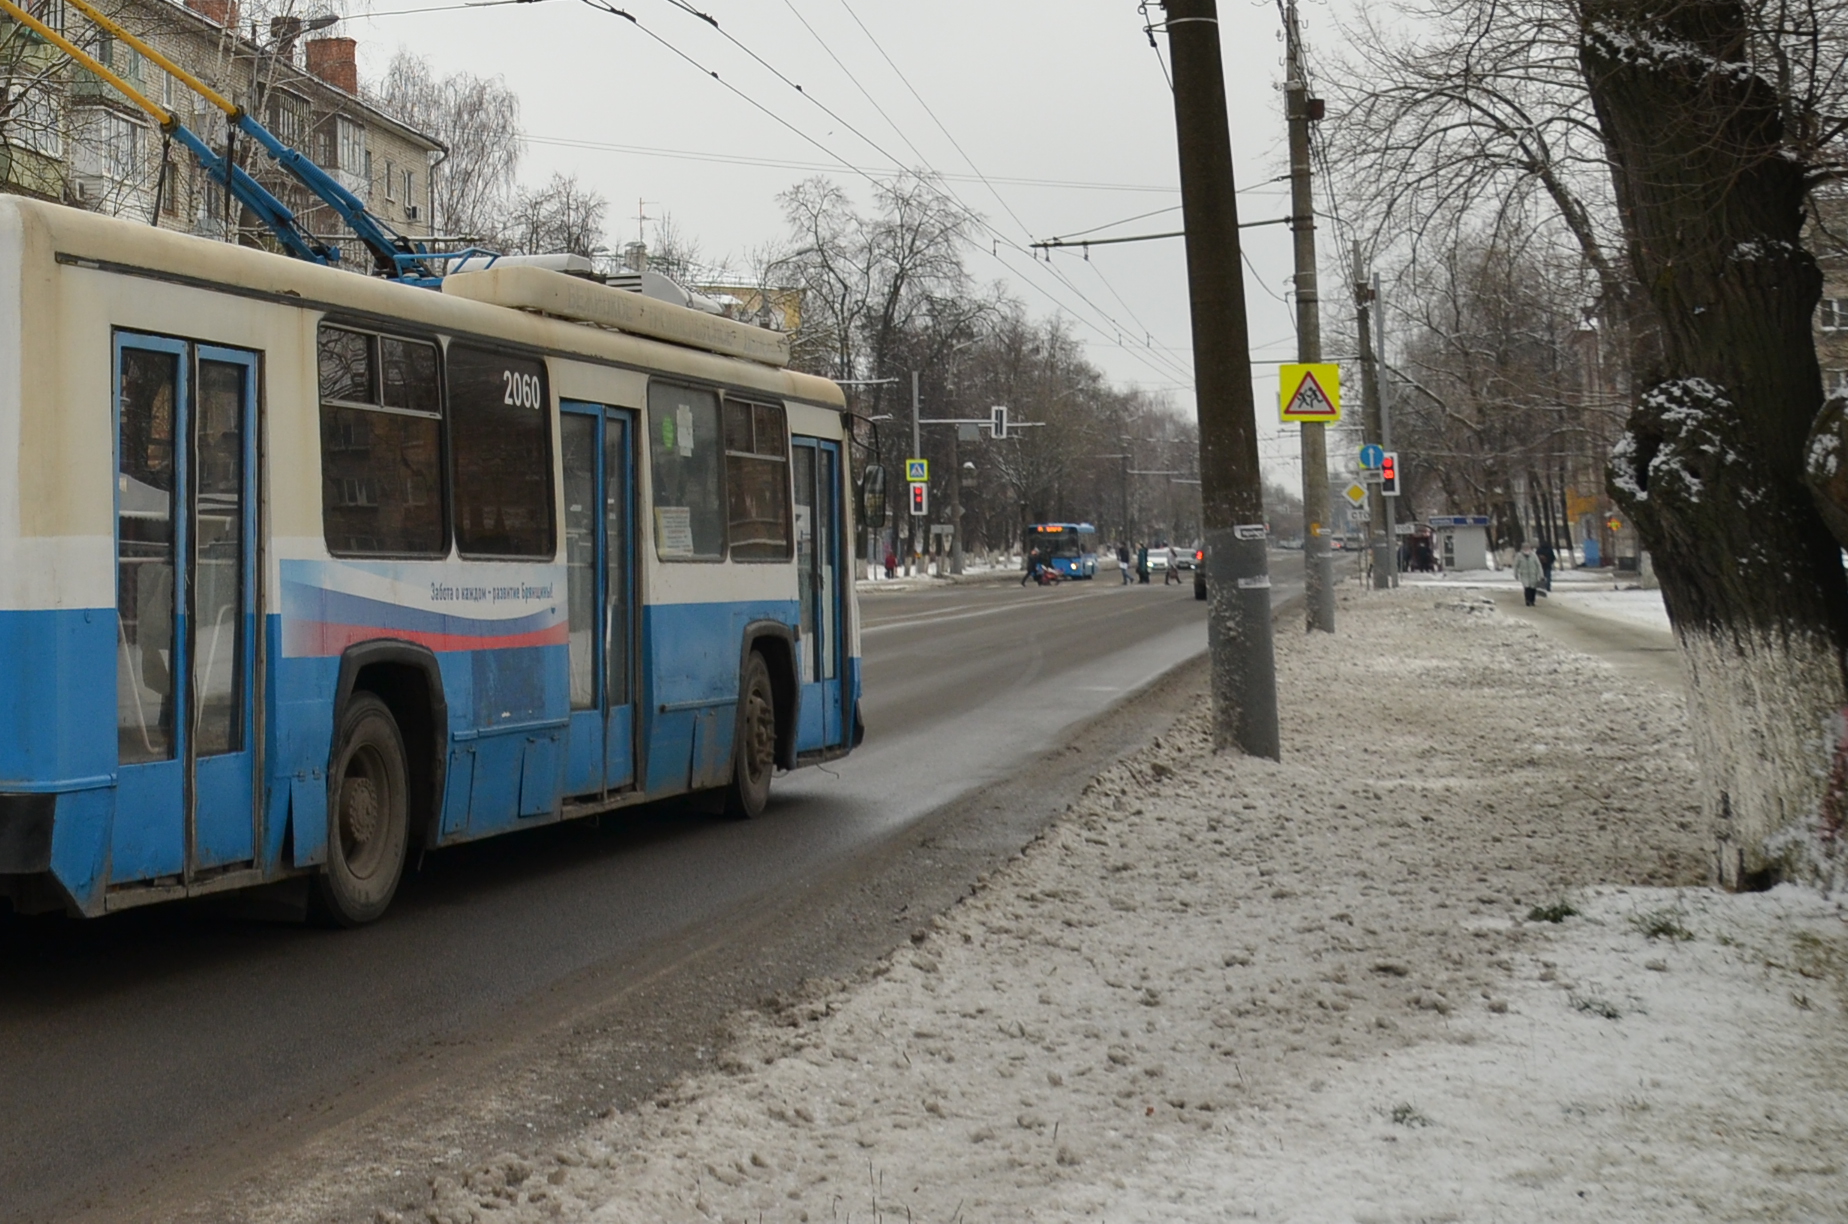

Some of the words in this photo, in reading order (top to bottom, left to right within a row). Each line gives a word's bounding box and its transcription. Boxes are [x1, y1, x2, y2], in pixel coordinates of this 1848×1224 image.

[504, 370, 540, 409] 2060
[431, 582, 454, 601] Забота
[455, 587, 460, 601] о
[461, 587, 486, 602] каждом
[492, 587, 520, 604] развитие
